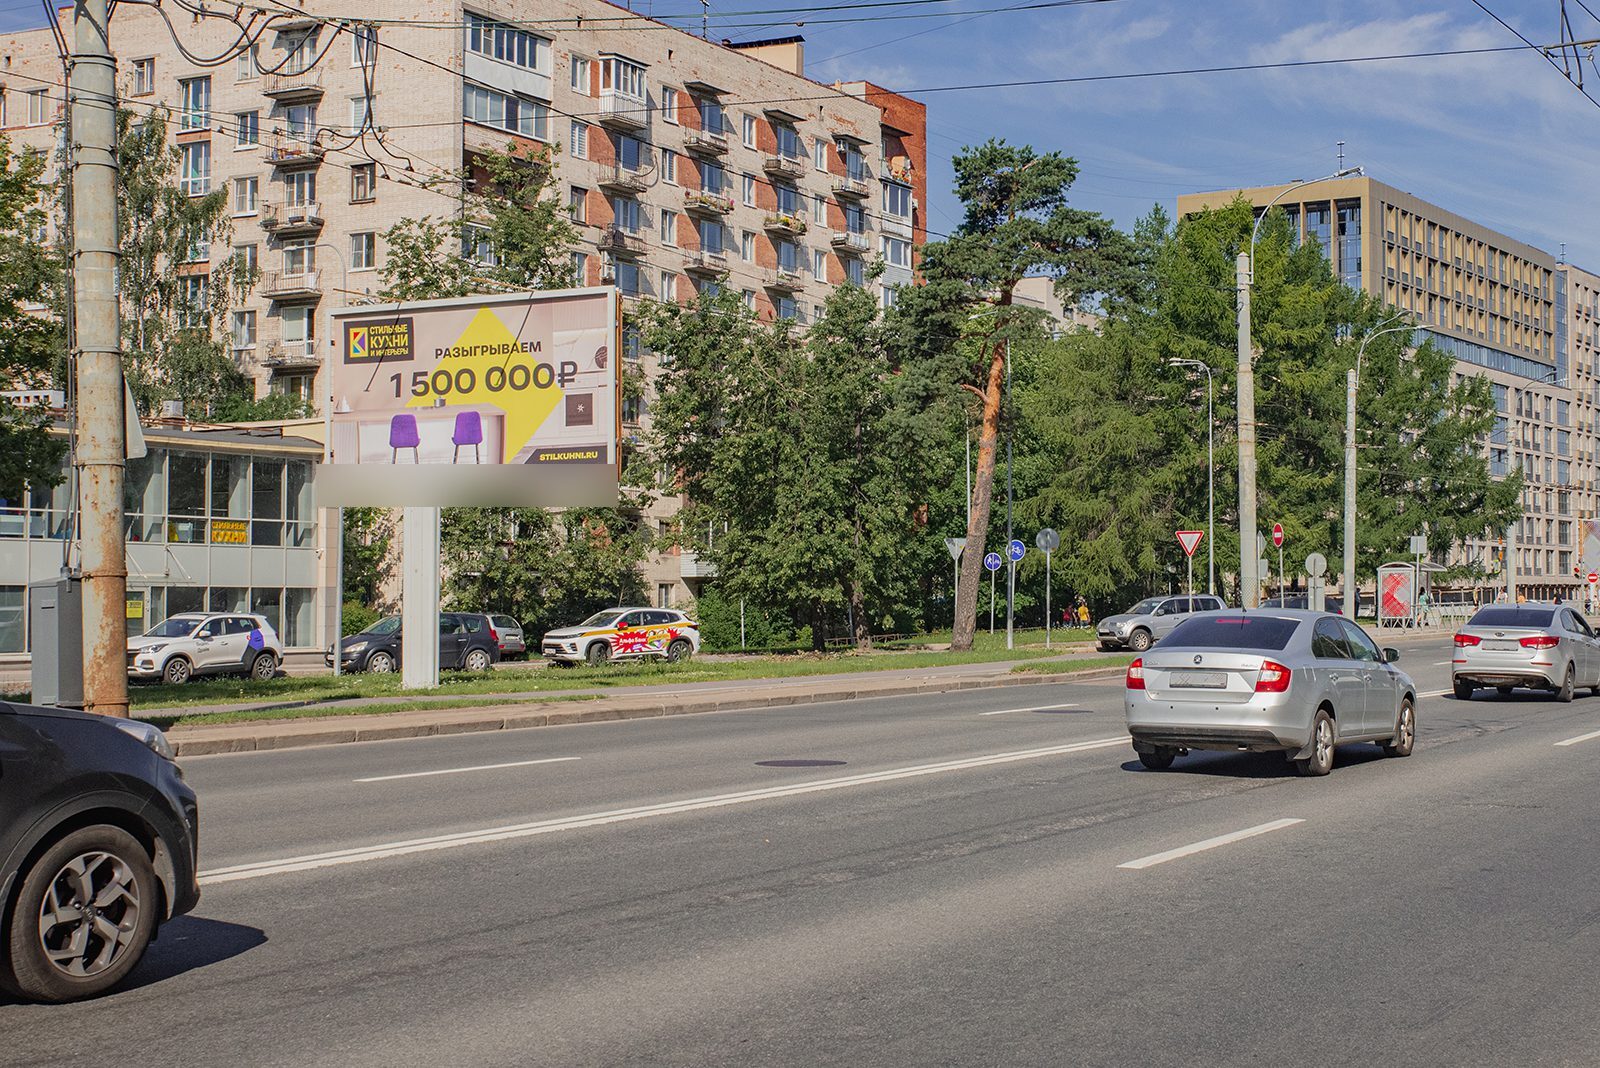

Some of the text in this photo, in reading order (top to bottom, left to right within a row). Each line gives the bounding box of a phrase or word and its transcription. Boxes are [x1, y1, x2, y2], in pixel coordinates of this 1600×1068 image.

[370, 324, 408, 335] СТИЛЬНЫЕ
[370, 334, 409, 348] КУХНИ
[435, 341, 542, 359] РАЗЫГРЫВАЕМ
[390, 373, 402, 398] 1
[411, 368, 476, 397] 500
[540, 451, 598, 461] STILKUHNI.RU
